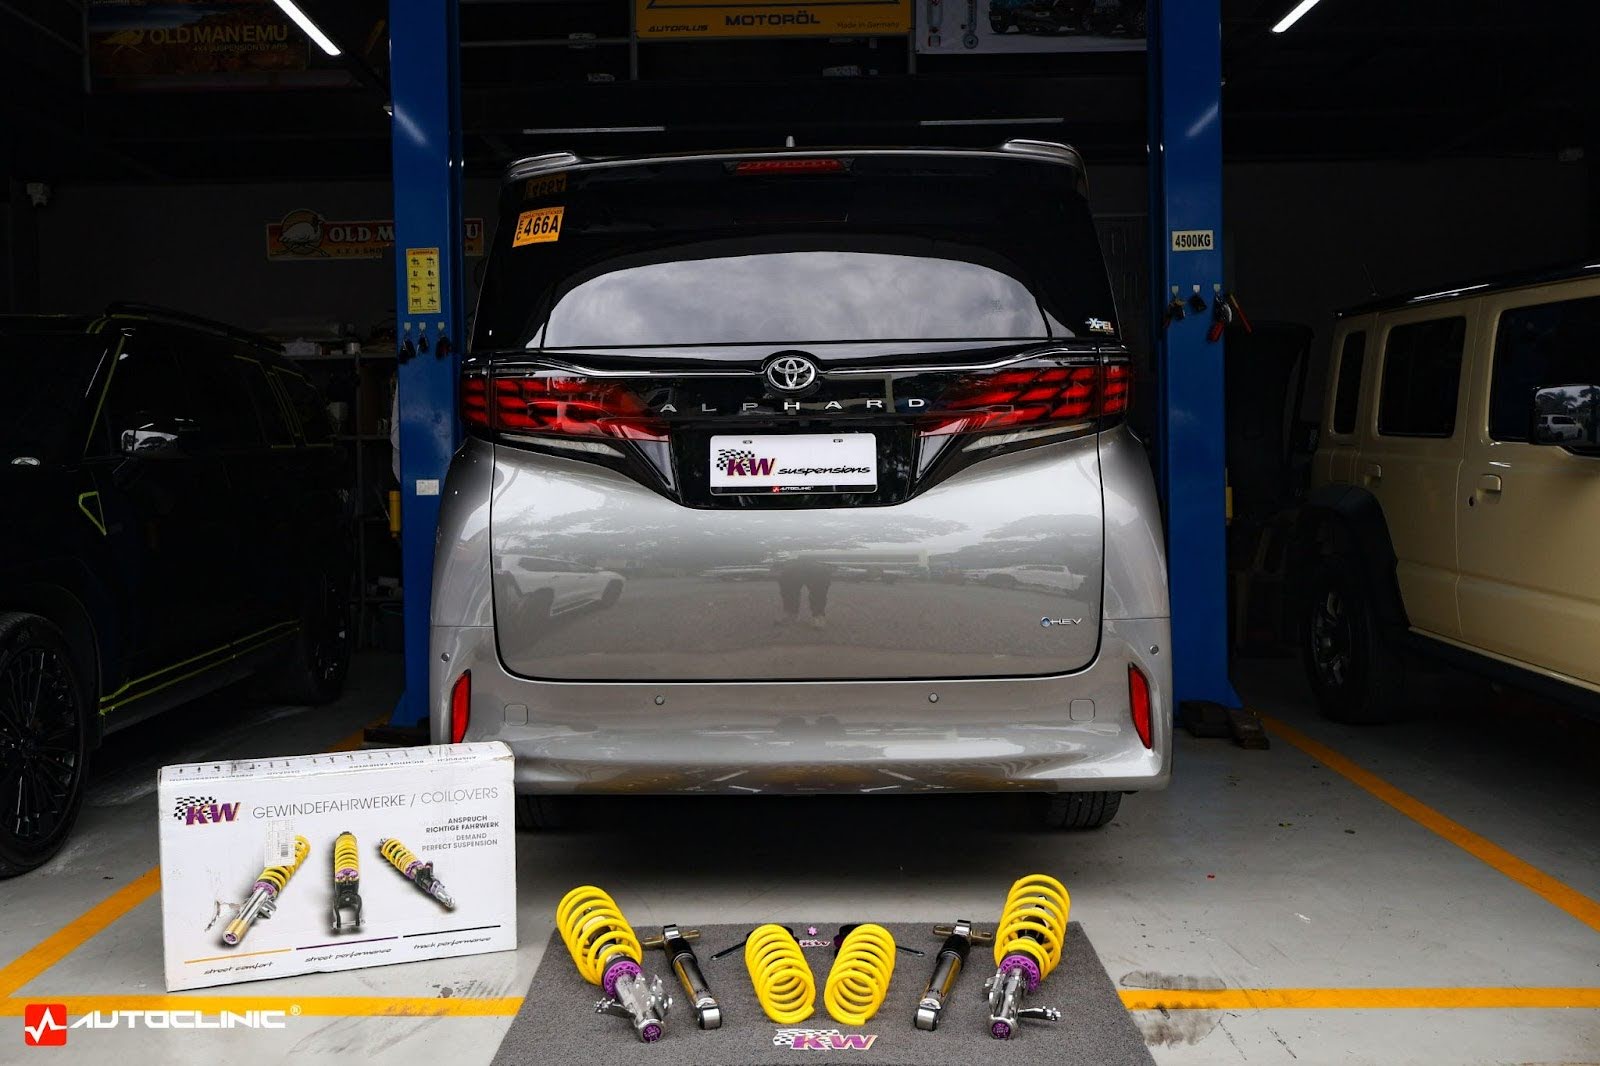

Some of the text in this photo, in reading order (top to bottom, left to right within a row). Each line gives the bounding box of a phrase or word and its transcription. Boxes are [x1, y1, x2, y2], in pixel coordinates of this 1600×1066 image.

[725, 10, 820, 26] MOTORÖL
[150, 24, 288, 44] OLD MAN EMU
[648, 24, 708, 33] AUTOPLUS
[524, 215, 559, 236] 466A
[329, 225, 371, 242] OLD
[1175, 234, 1211, 248] 4500KG
[1087, 317, 1114, 330] XPEL
[659, 398, 926, 413] ALPHARD
[727, 457, 871, 477] KW suspensions
[1050, 617, 1082, 625] HEV
[253, 794, 406, 819] GEWINDEFAHRWERKE
[421, 787, 498, 804] COILOVERS
[185, 802, 241, 826] KW
[448, 815, 488, 824] ANSPRUCH
[426, 821, 499, 833] RICHTIGE FAHRWERK
[456, 832, 487, 841] DEMAND
[422, 839, 498, 851] PERFECT SUSPENSION
[437, 937, 491, 949] performance
[305, 948, 392, 962] street performance
[204, 961, 274, 975] street comfort
[790, 1034, 878, 1051] KW
